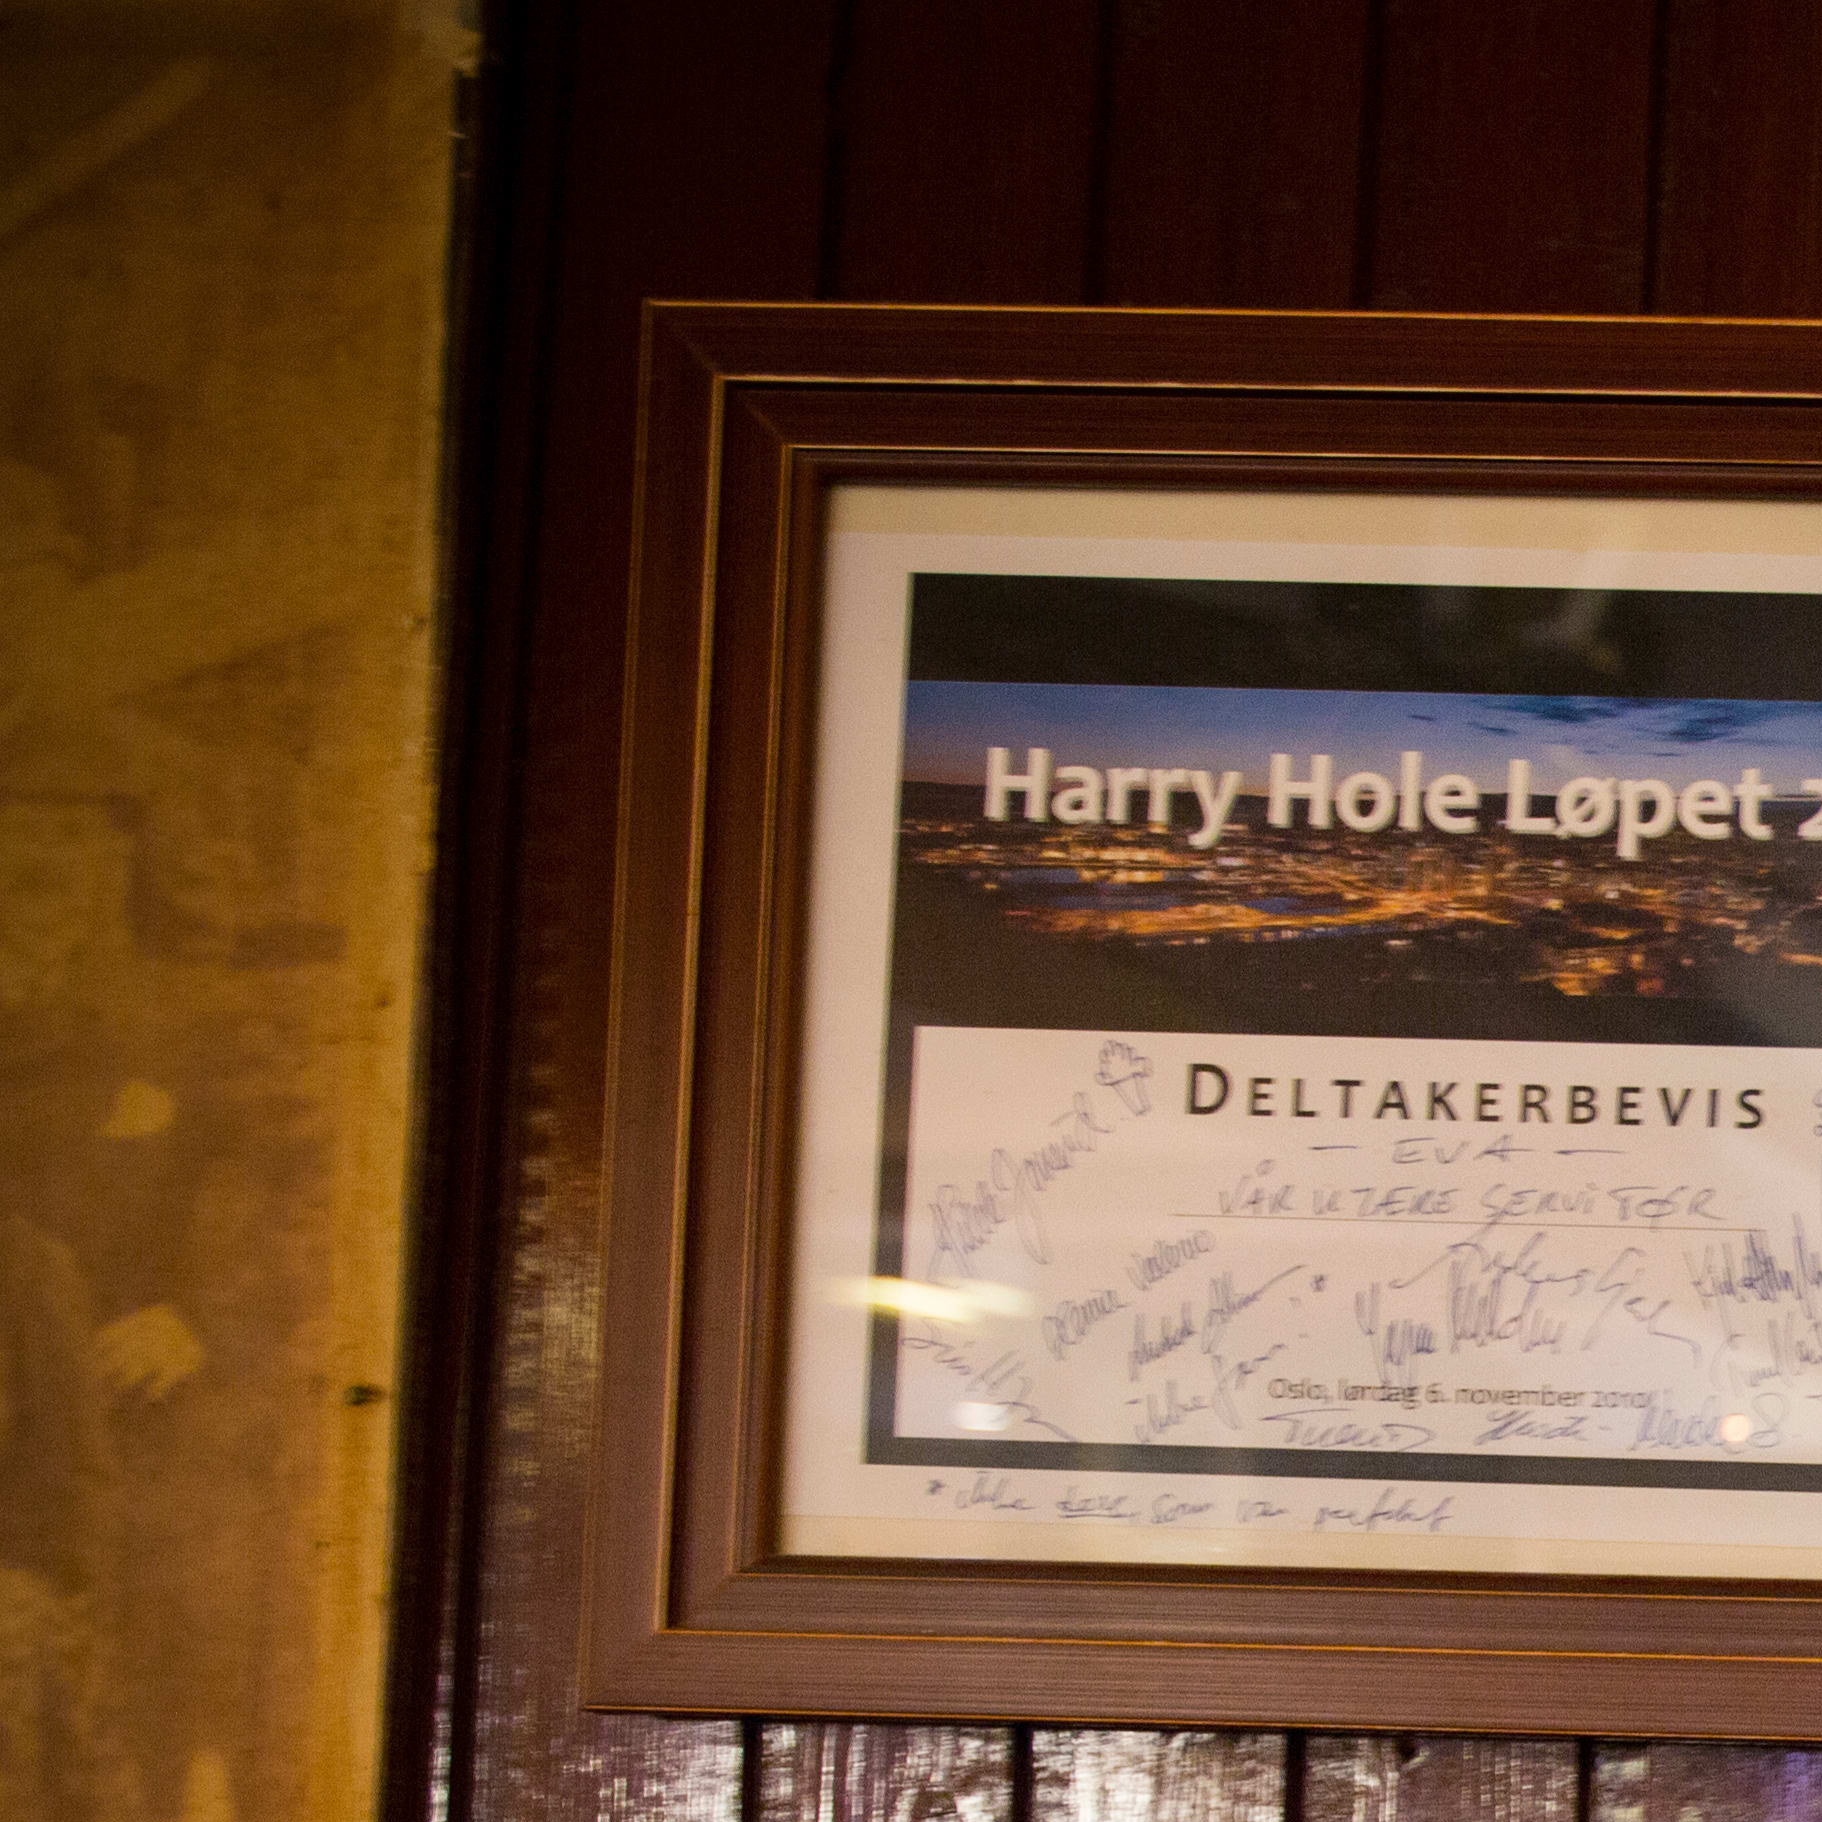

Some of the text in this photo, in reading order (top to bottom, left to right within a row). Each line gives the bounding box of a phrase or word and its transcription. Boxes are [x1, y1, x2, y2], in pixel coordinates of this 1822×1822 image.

[983, 747, 1243, 849] Harry
[1267, 751, 1483, 834] Hole
[1505, 759, 1774, 861] Løpet
[1184, 1062, 1767, 1130] DELTAKERBEVIS
[1391, 1135, 1536, 1165] EVA
[1454, 1385, 1585, 1409] november
